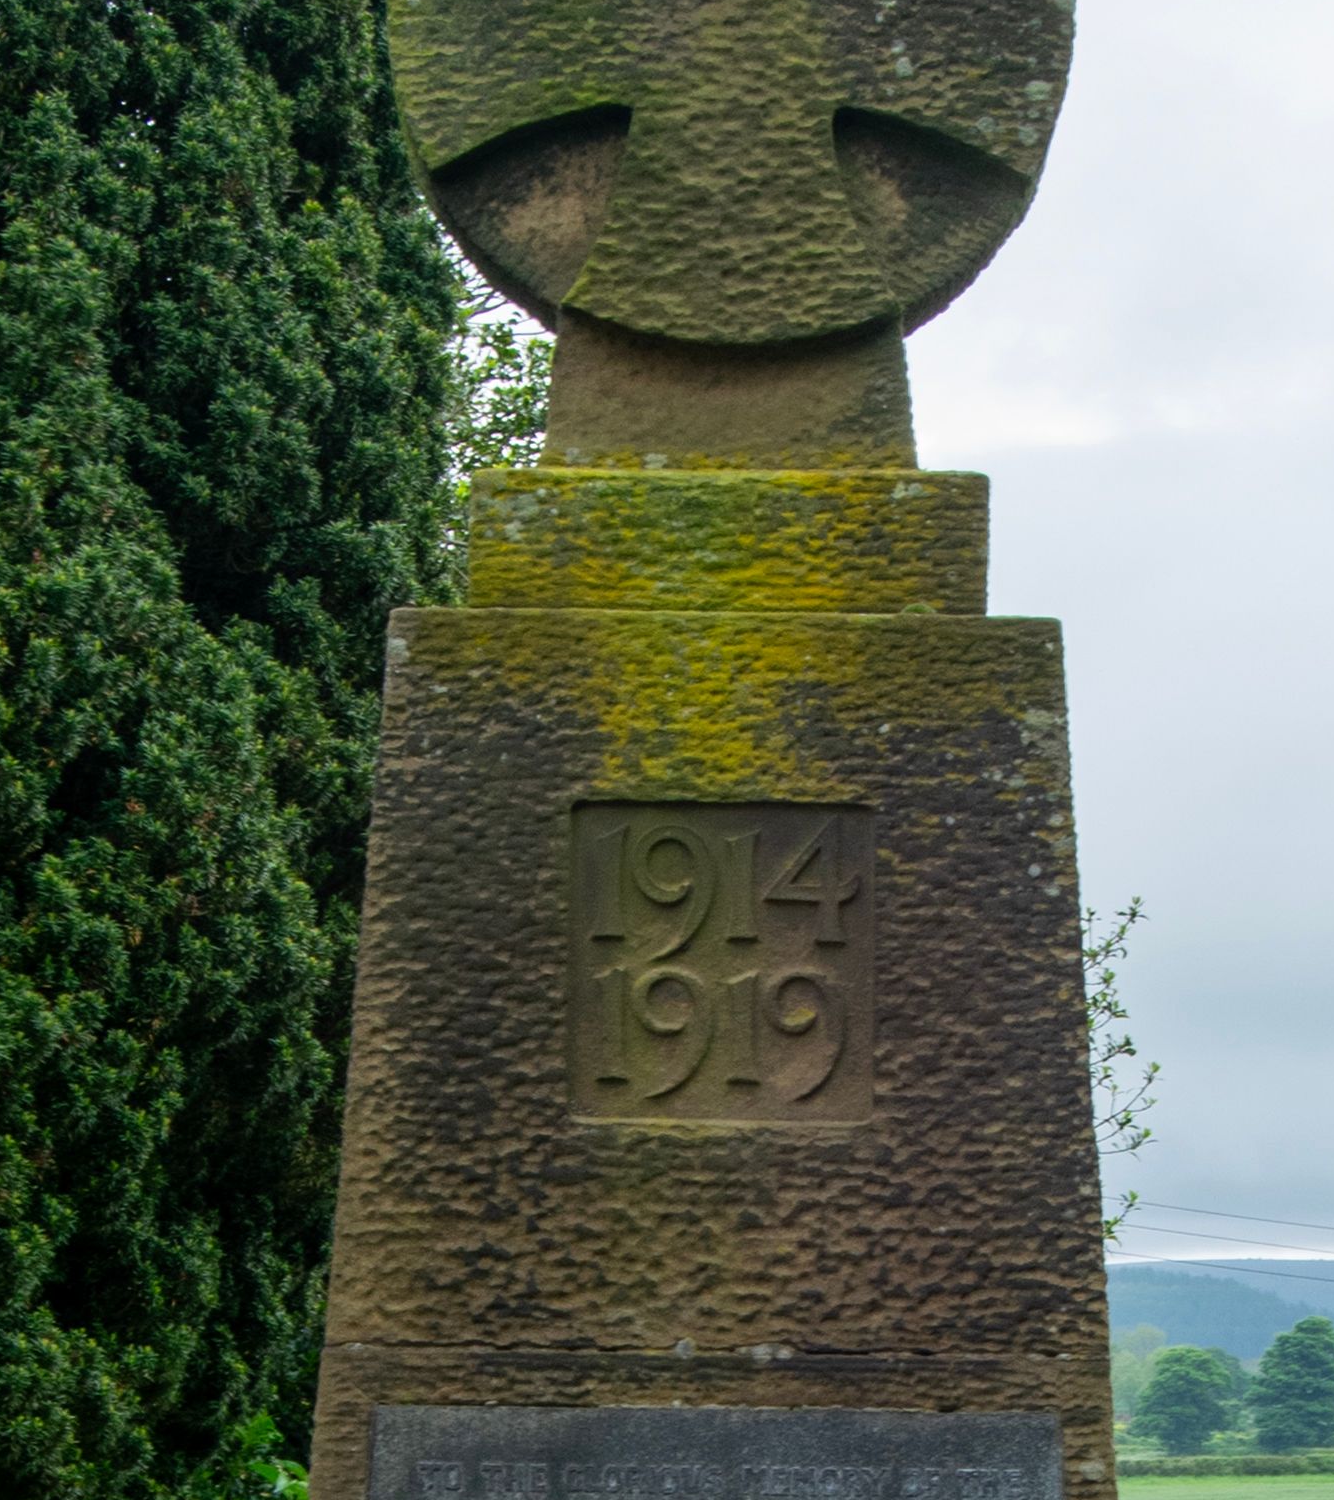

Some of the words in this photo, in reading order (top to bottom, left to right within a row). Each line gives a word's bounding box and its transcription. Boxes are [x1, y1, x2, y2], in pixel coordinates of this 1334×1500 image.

[590, 815, 861, 963] 1914
[591, 964, 849, 1102] 1919
[416, 1459, 464, 1494] TO
[479, 1459, 549, 1497] THE
[562, 1461, 724, 1498] GLORIOUS
[741, 1463, 890, 1499] MEMORY
[901, 1466, 943, 1499] OF
[955, 1467, 1024, 1499] THE
